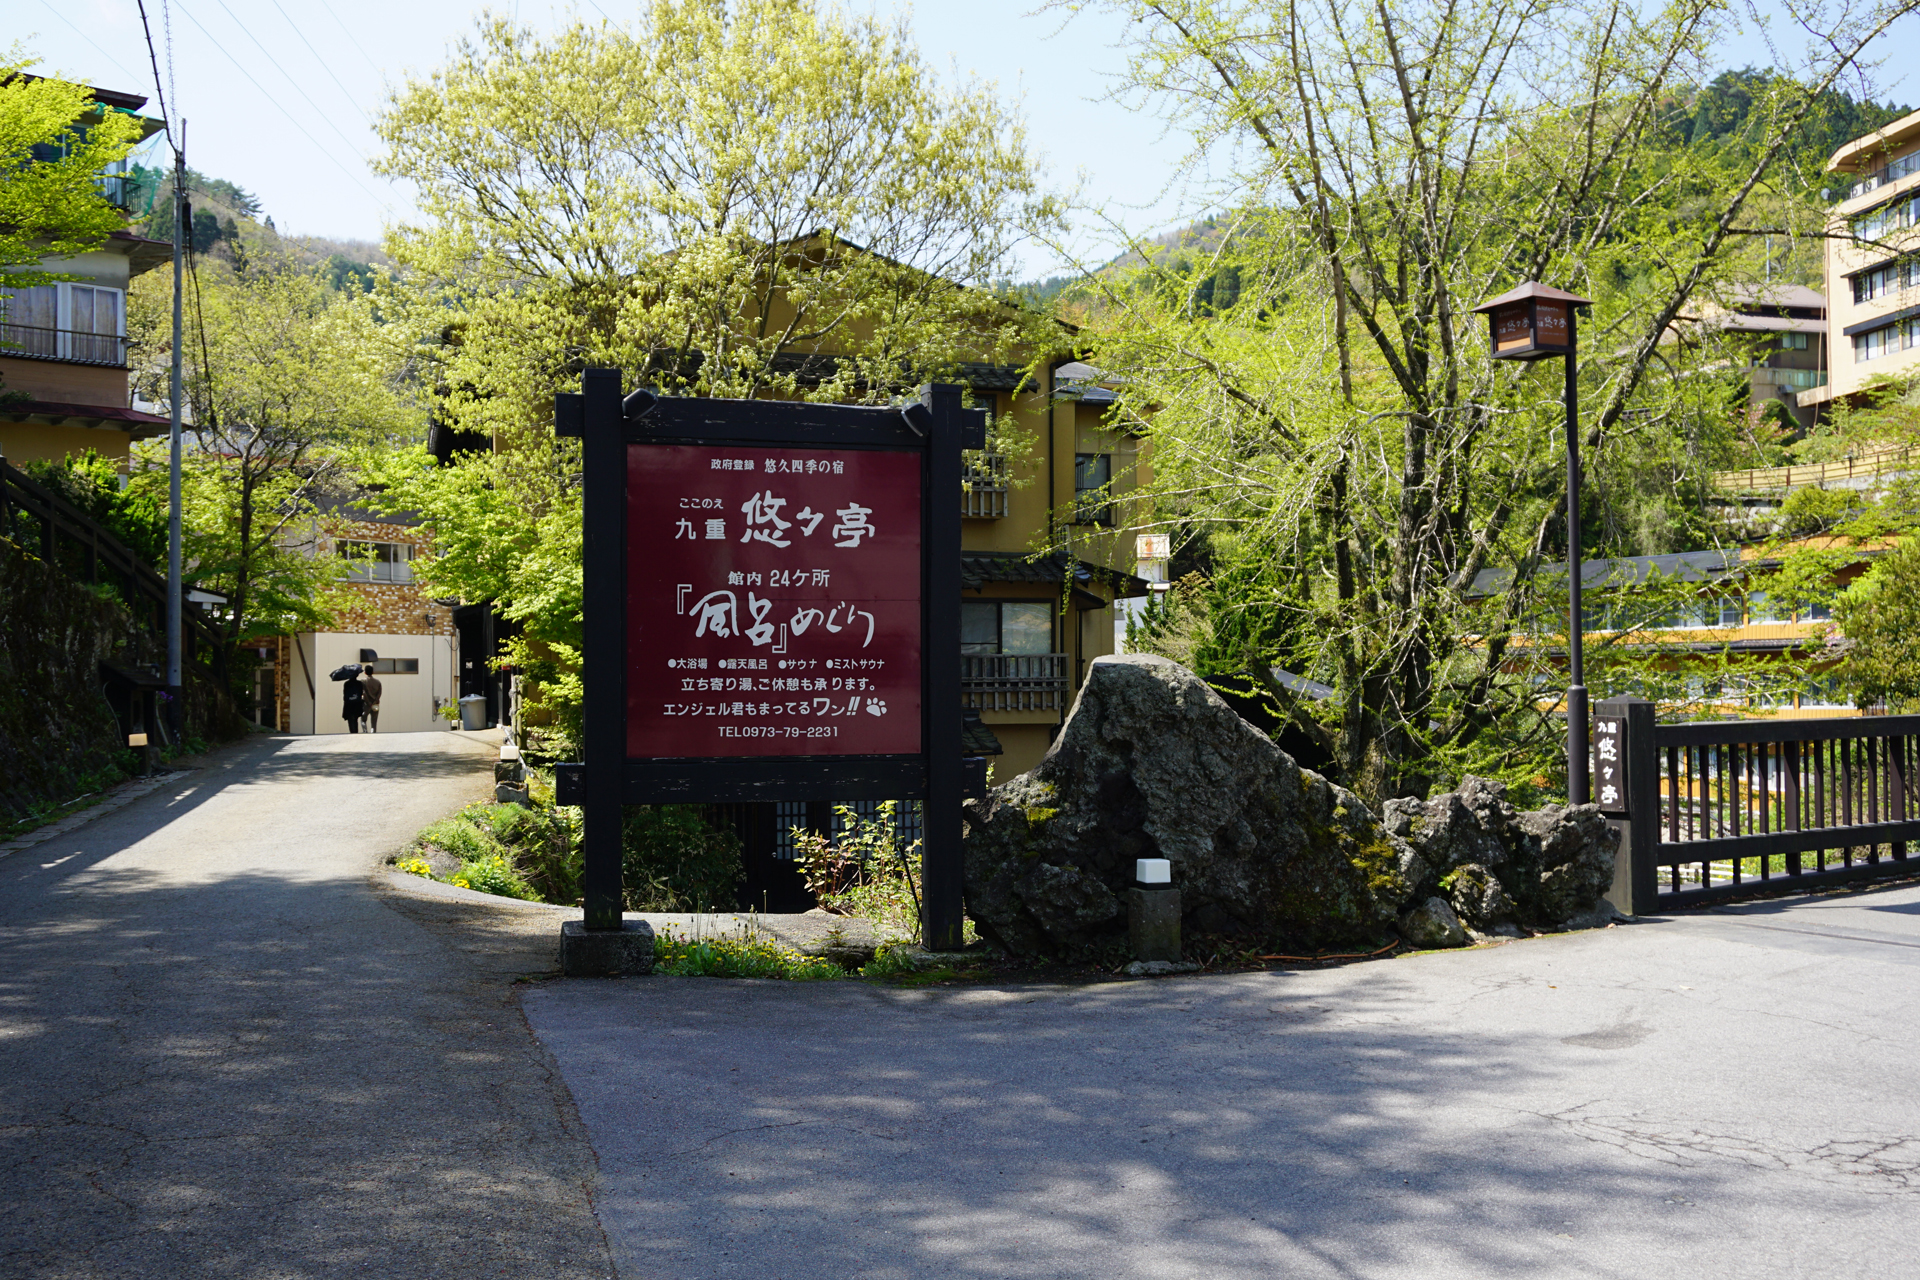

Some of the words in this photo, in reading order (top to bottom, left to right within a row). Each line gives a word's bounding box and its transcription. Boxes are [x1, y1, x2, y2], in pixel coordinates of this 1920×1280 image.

[710, 458, 755, 471] 政府登録
[764, 457, 844, 474] 悠久四季の宿
[679, 497, 724, 510] ここのえ
[675, 517, 727, 540] 九重
[727, 570, 762, 586] 館内
[718, 726, 838, 738] TEL0973-79-2231
